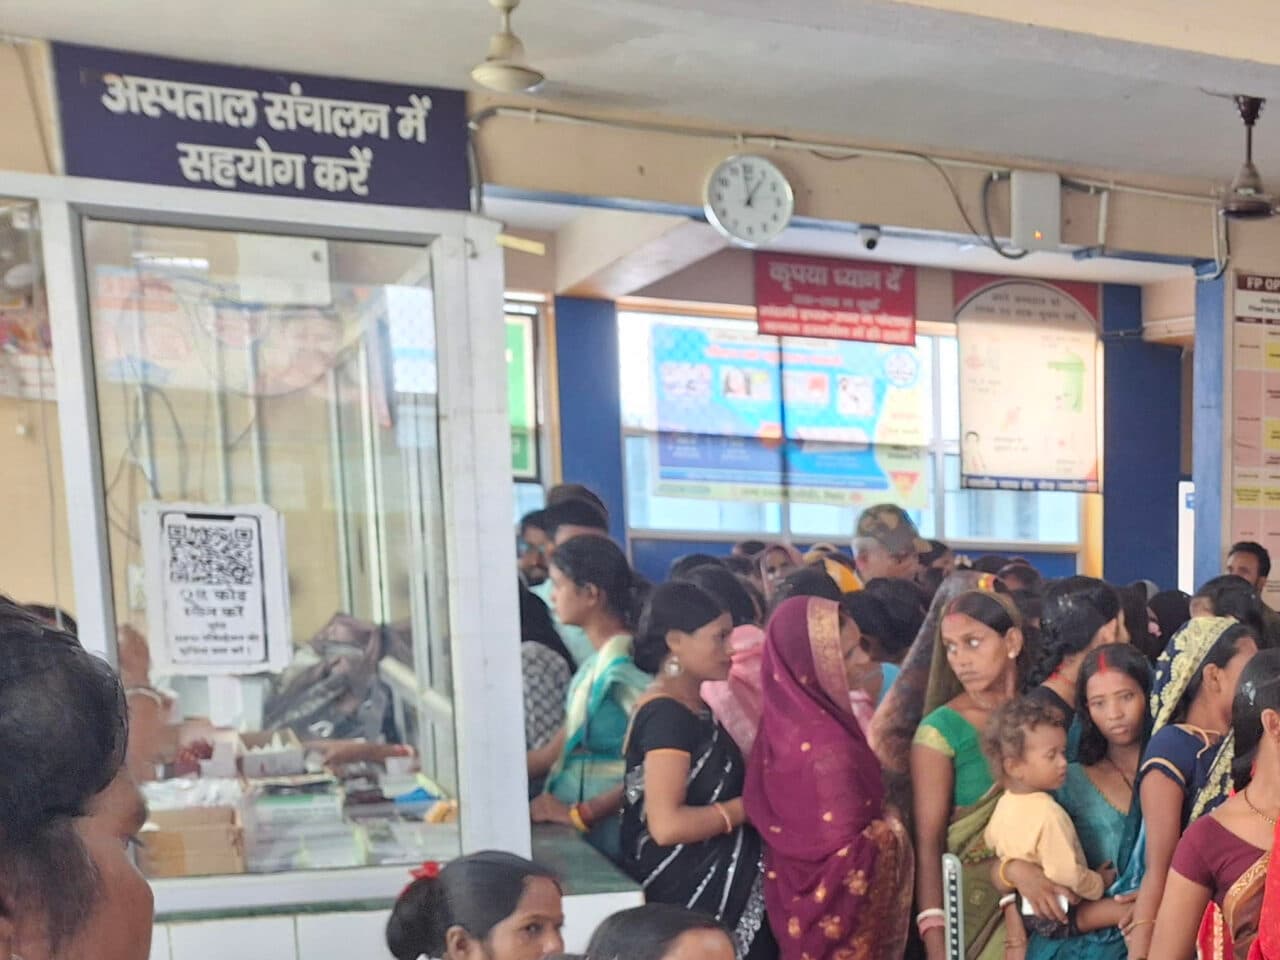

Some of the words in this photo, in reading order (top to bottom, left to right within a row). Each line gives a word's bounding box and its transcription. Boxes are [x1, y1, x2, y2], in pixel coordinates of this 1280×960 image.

[102, 75, 258, 127] अस्पताल
[262, 82, 390, 139] संचालन
[396, 94, 432, 143] में
[176, 136, 306, 189] सहयोग
[311, 145, 373, 195] करें
[769, 262, 828, 292] कृपया
[1247, 277, 1263, 289] FP
